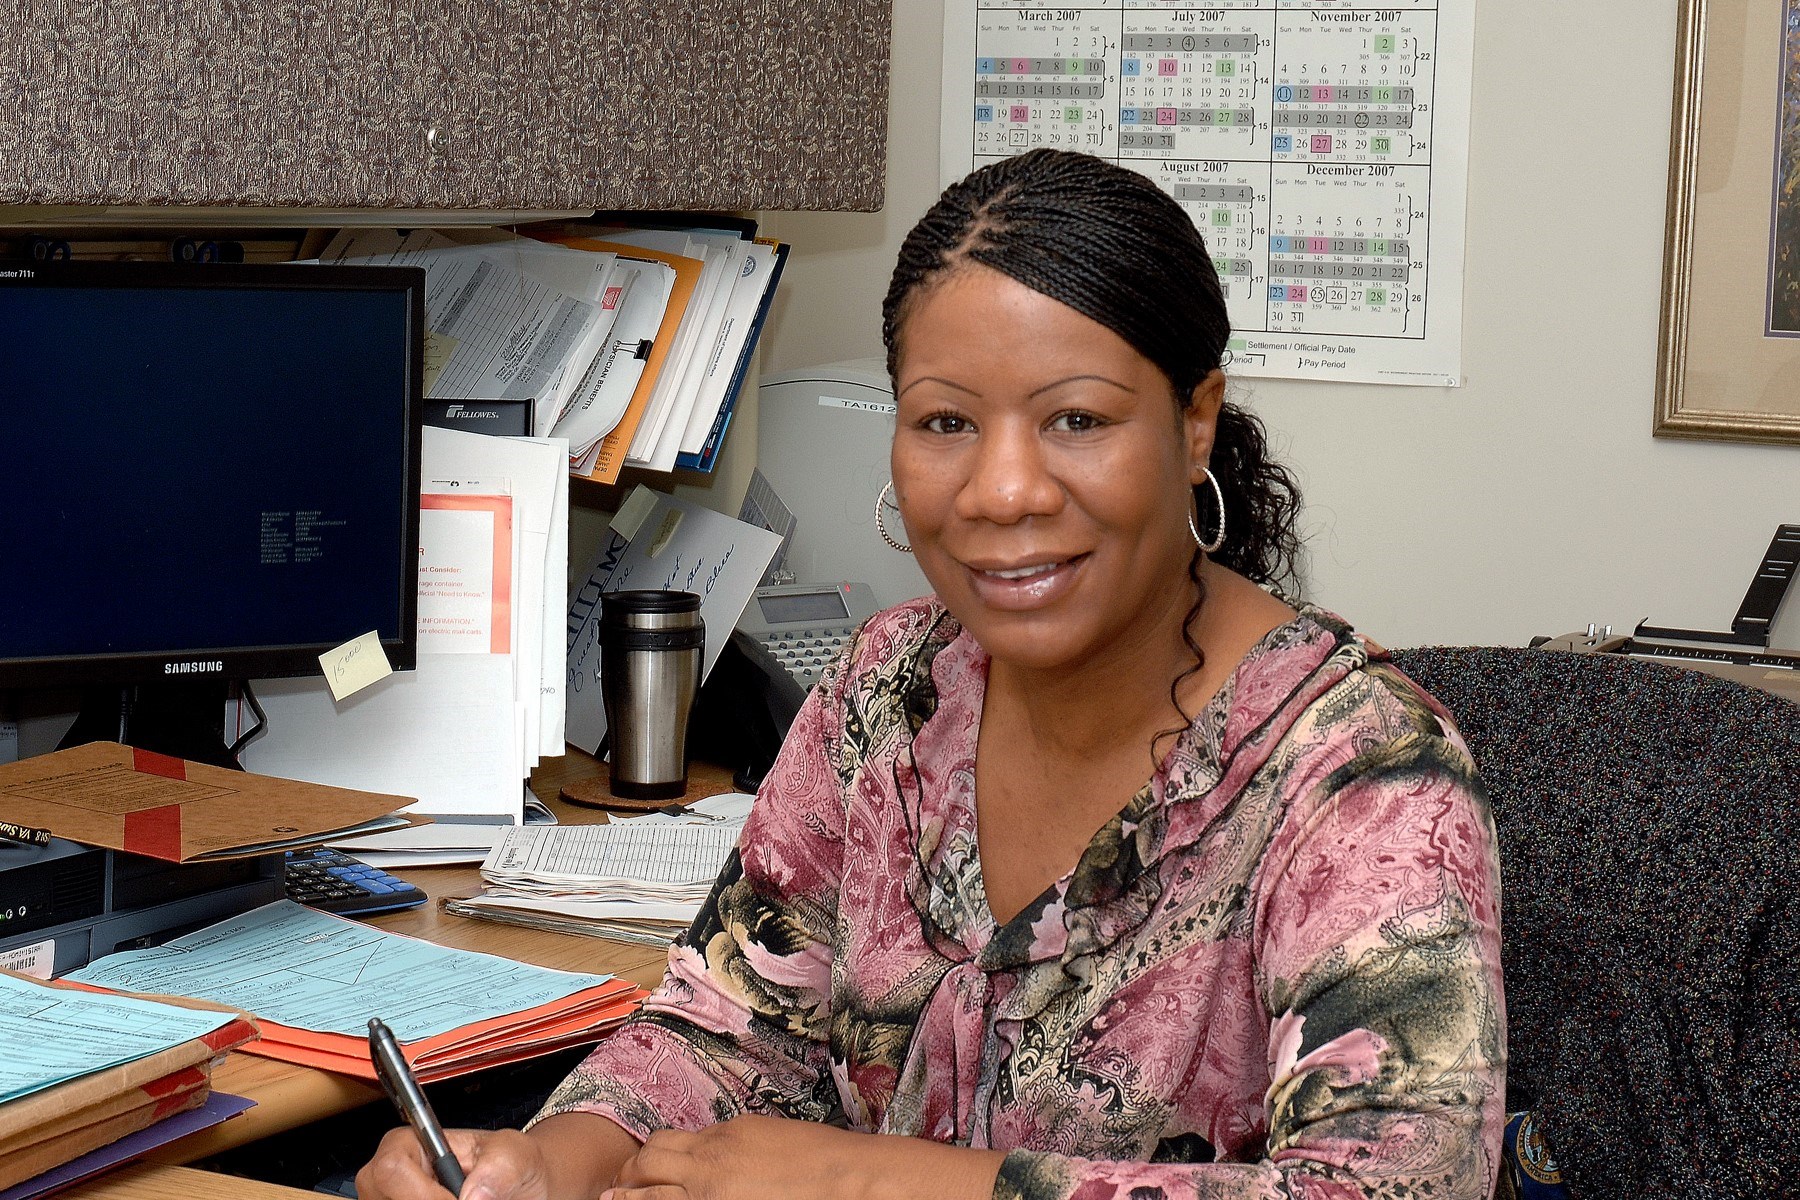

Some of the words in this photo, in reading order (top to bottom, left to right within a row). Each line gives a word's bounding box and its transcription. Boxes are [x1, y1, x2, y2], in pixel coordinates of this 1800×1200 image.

[1018, 11, 1052, 20] March
[1057, 11, 1081, 21] 2007
[1172, 11, 1195, 24] July
[1200, 11, 1225, 21] 2007
[1311, 11, 1371, 21] November
[1375, 11, 1401, 21] 2007
[1128, 63, 1133, 71] 8
[1147, 63, 1152, 71] 9
[1164, 63, 1174, 72] 10
[1183, 63, 1191, 72] 11
[1203, 63, 1212, 72] 12
[1222, 63, 1231, 73] 13
[1241, 64, 1250, 72] 14
[1126, 87, 1135, 96] 15
[1145, 87, 1154, 96] 16
[1164, 87, 1173, 96] 17
[1183, 88, 1192, 96] 18
[1202, 88, 1211, 97] 19
[1220, 88, 1230, 97] 20
[1239, 88, 1248, 97] 21
[1279, 114, 1288, 123] 18
[1299, 114, 1308, 123] 19
[1317, 114, 1328, 123] 20
[1336, 115, 1346, 124] 21
[1356, 116, 1367, 124] 22
[1376, 115, 1387, 125] 23
[1396, 115, 1407, 125] 24
[978, 132, 988, 141] 25
[996, 133, 1006, 142] 26
[1014, 134, 1024, 142] 27
[1032, 133, 1042, 142] 28
[1050, 134, 1060, 143] 29
[1068, 134, 1078, 143] 30
[1161, 162, 1198, 174] August
[1203, 162, 1228, 172] 2007
[1307, 164, 1364, 175] December
[1368, 166, 1394, 176] 2007
[1218, 238, 1227, 246] 17
[1237, 238, 1246, 247] 18
[1413, 261, 1422, 269] 25
[1412, 294, 1421, 302] 26
[1248, 341, 1287, 350] Settlement
[1294, 343, 1319, 351] Official
[1322, 345, 1336, 354] Pay
[1338, 345, 1355, 353] Date
[1304, 359, 1319, 368] Pay
[1321, 360, 1345, 368] Period
[582, 378, 604, 410] BENEFITS
[842, 401, 896, 412] TA1612
[165, 661, 222, 674] SAMSUNG
[19, 828, 30, 839] VA
[1526, 1164, 1553, 1181] AMERICA
